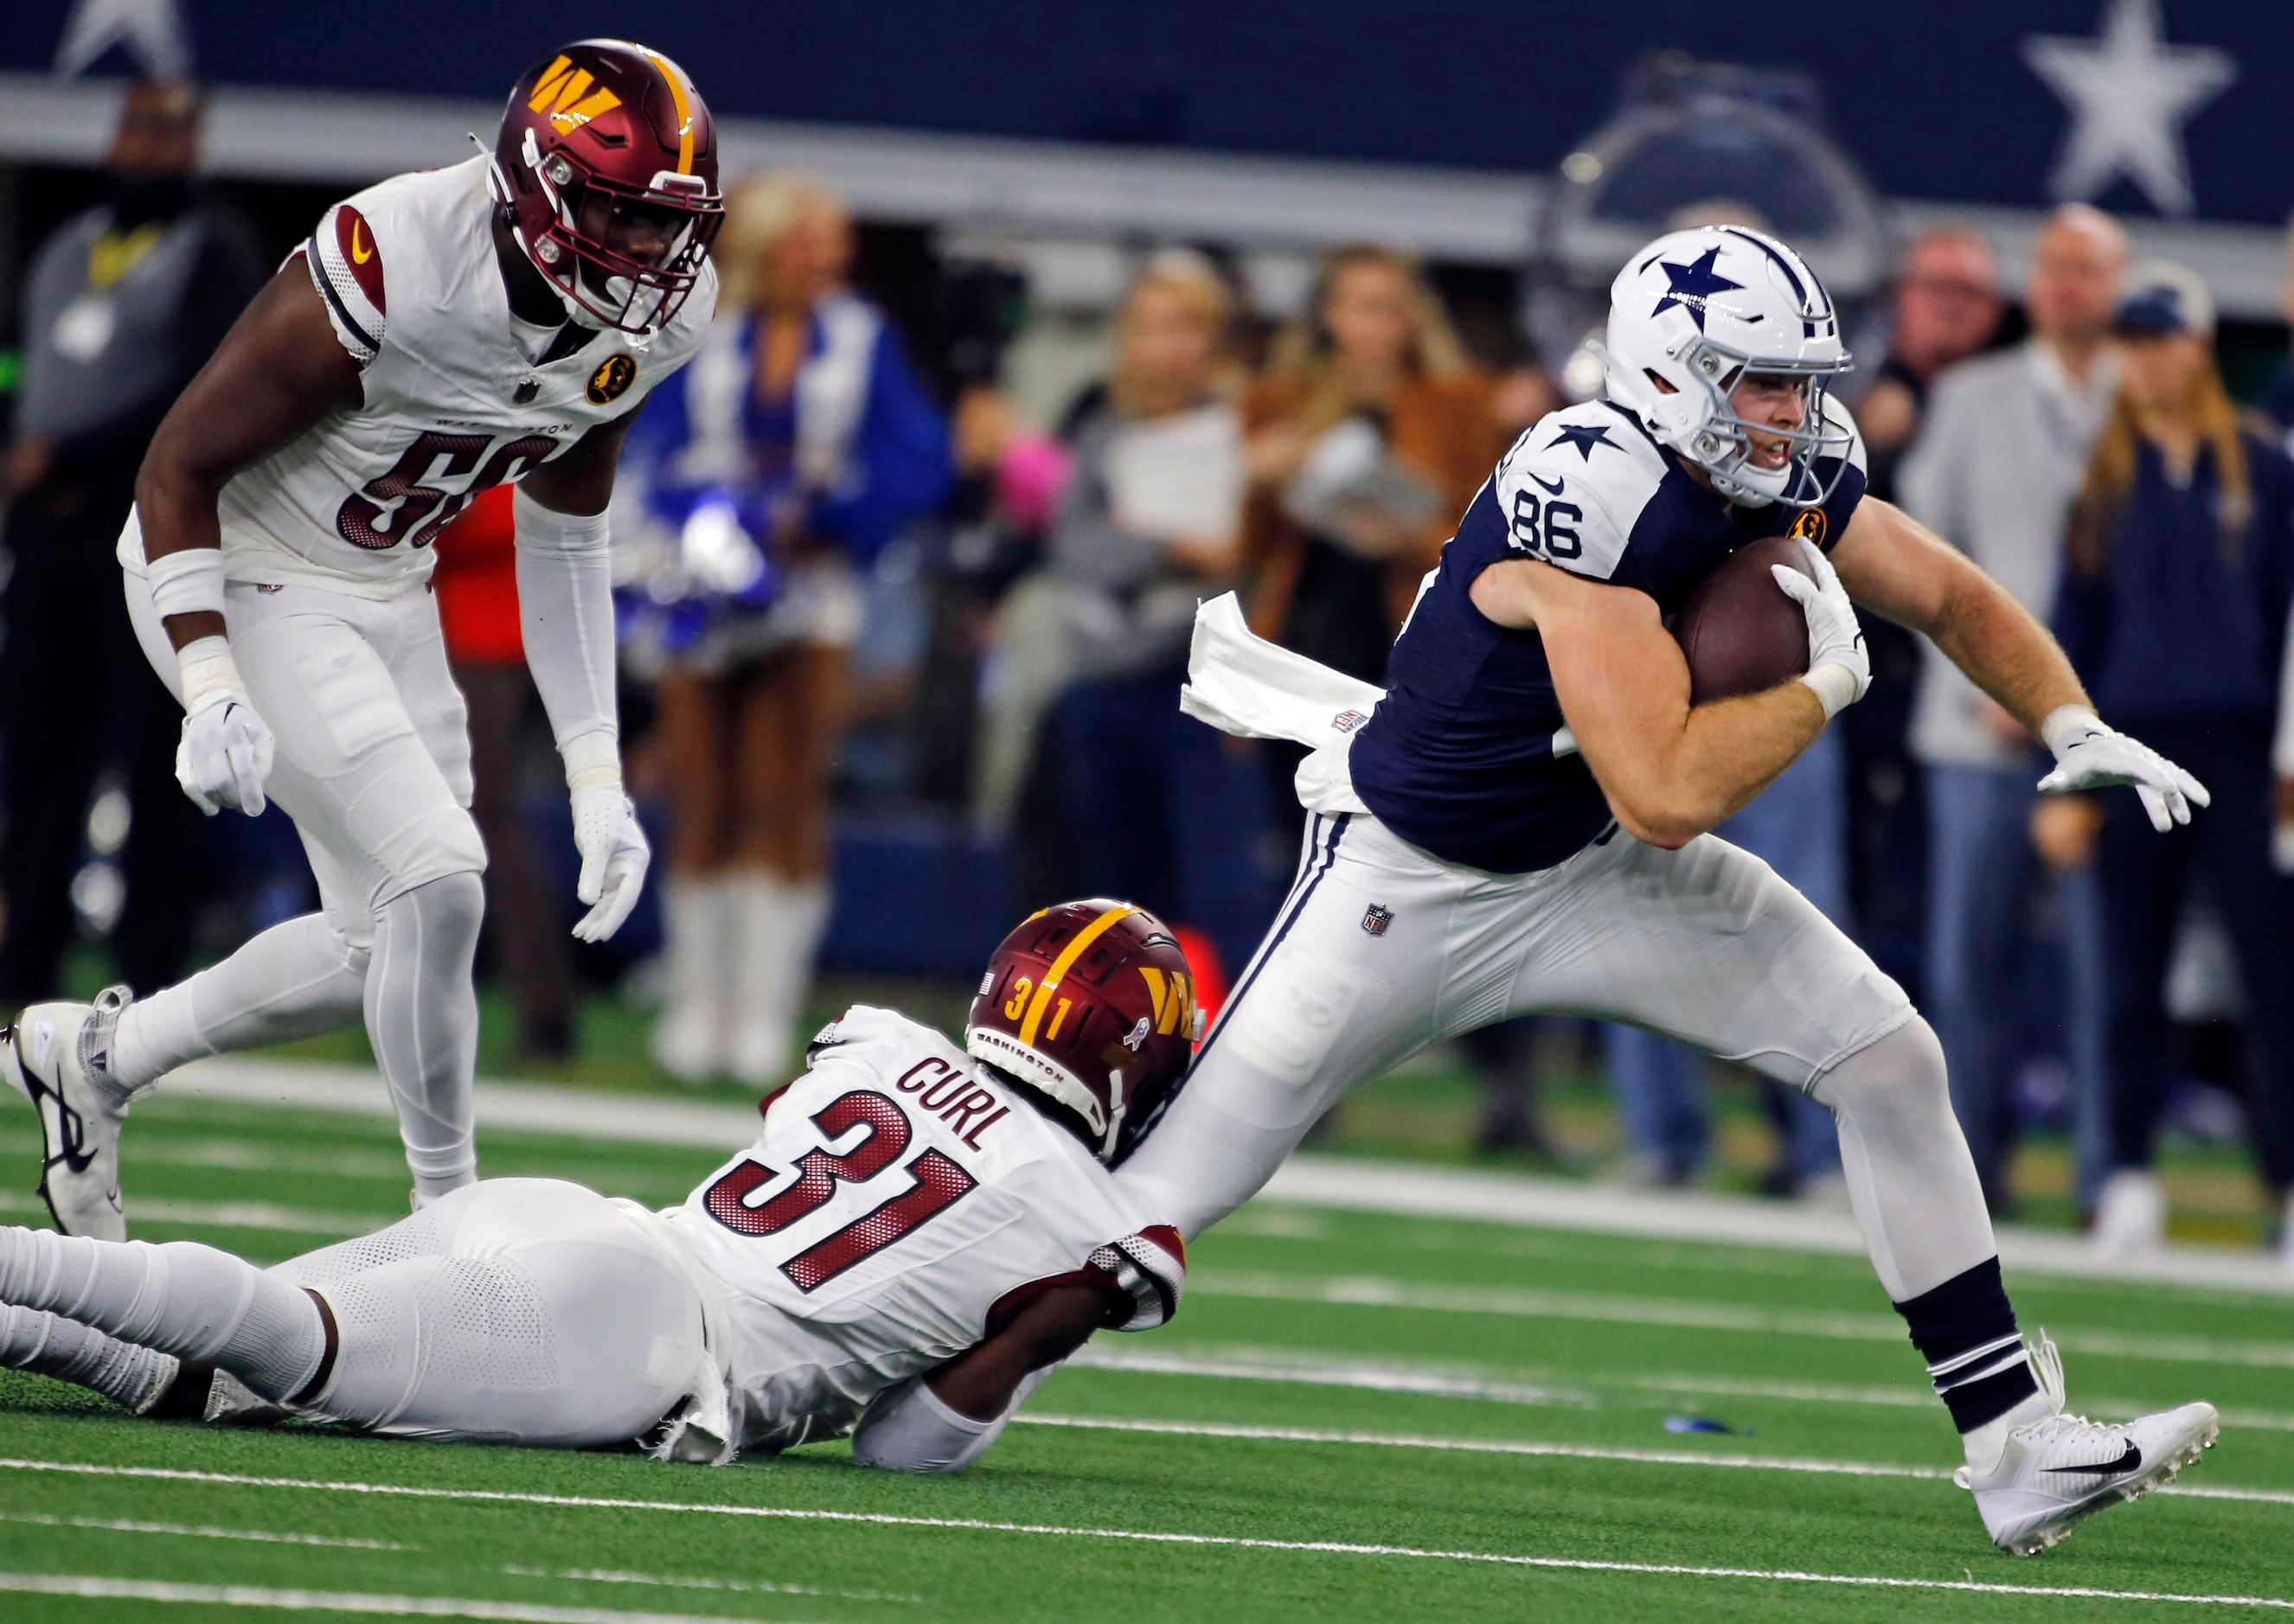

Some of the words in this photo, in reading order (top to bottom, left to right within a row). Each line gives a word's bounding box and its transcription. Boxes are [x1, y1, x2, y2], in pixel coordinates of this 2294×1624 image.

[1512, 489, 1583, 559] 86
[977, 1033, 1065, 1083] WASHINGTON
[895, 1057, 1011, 1154] CURL
[702, 1090, 980, 1295] 31
